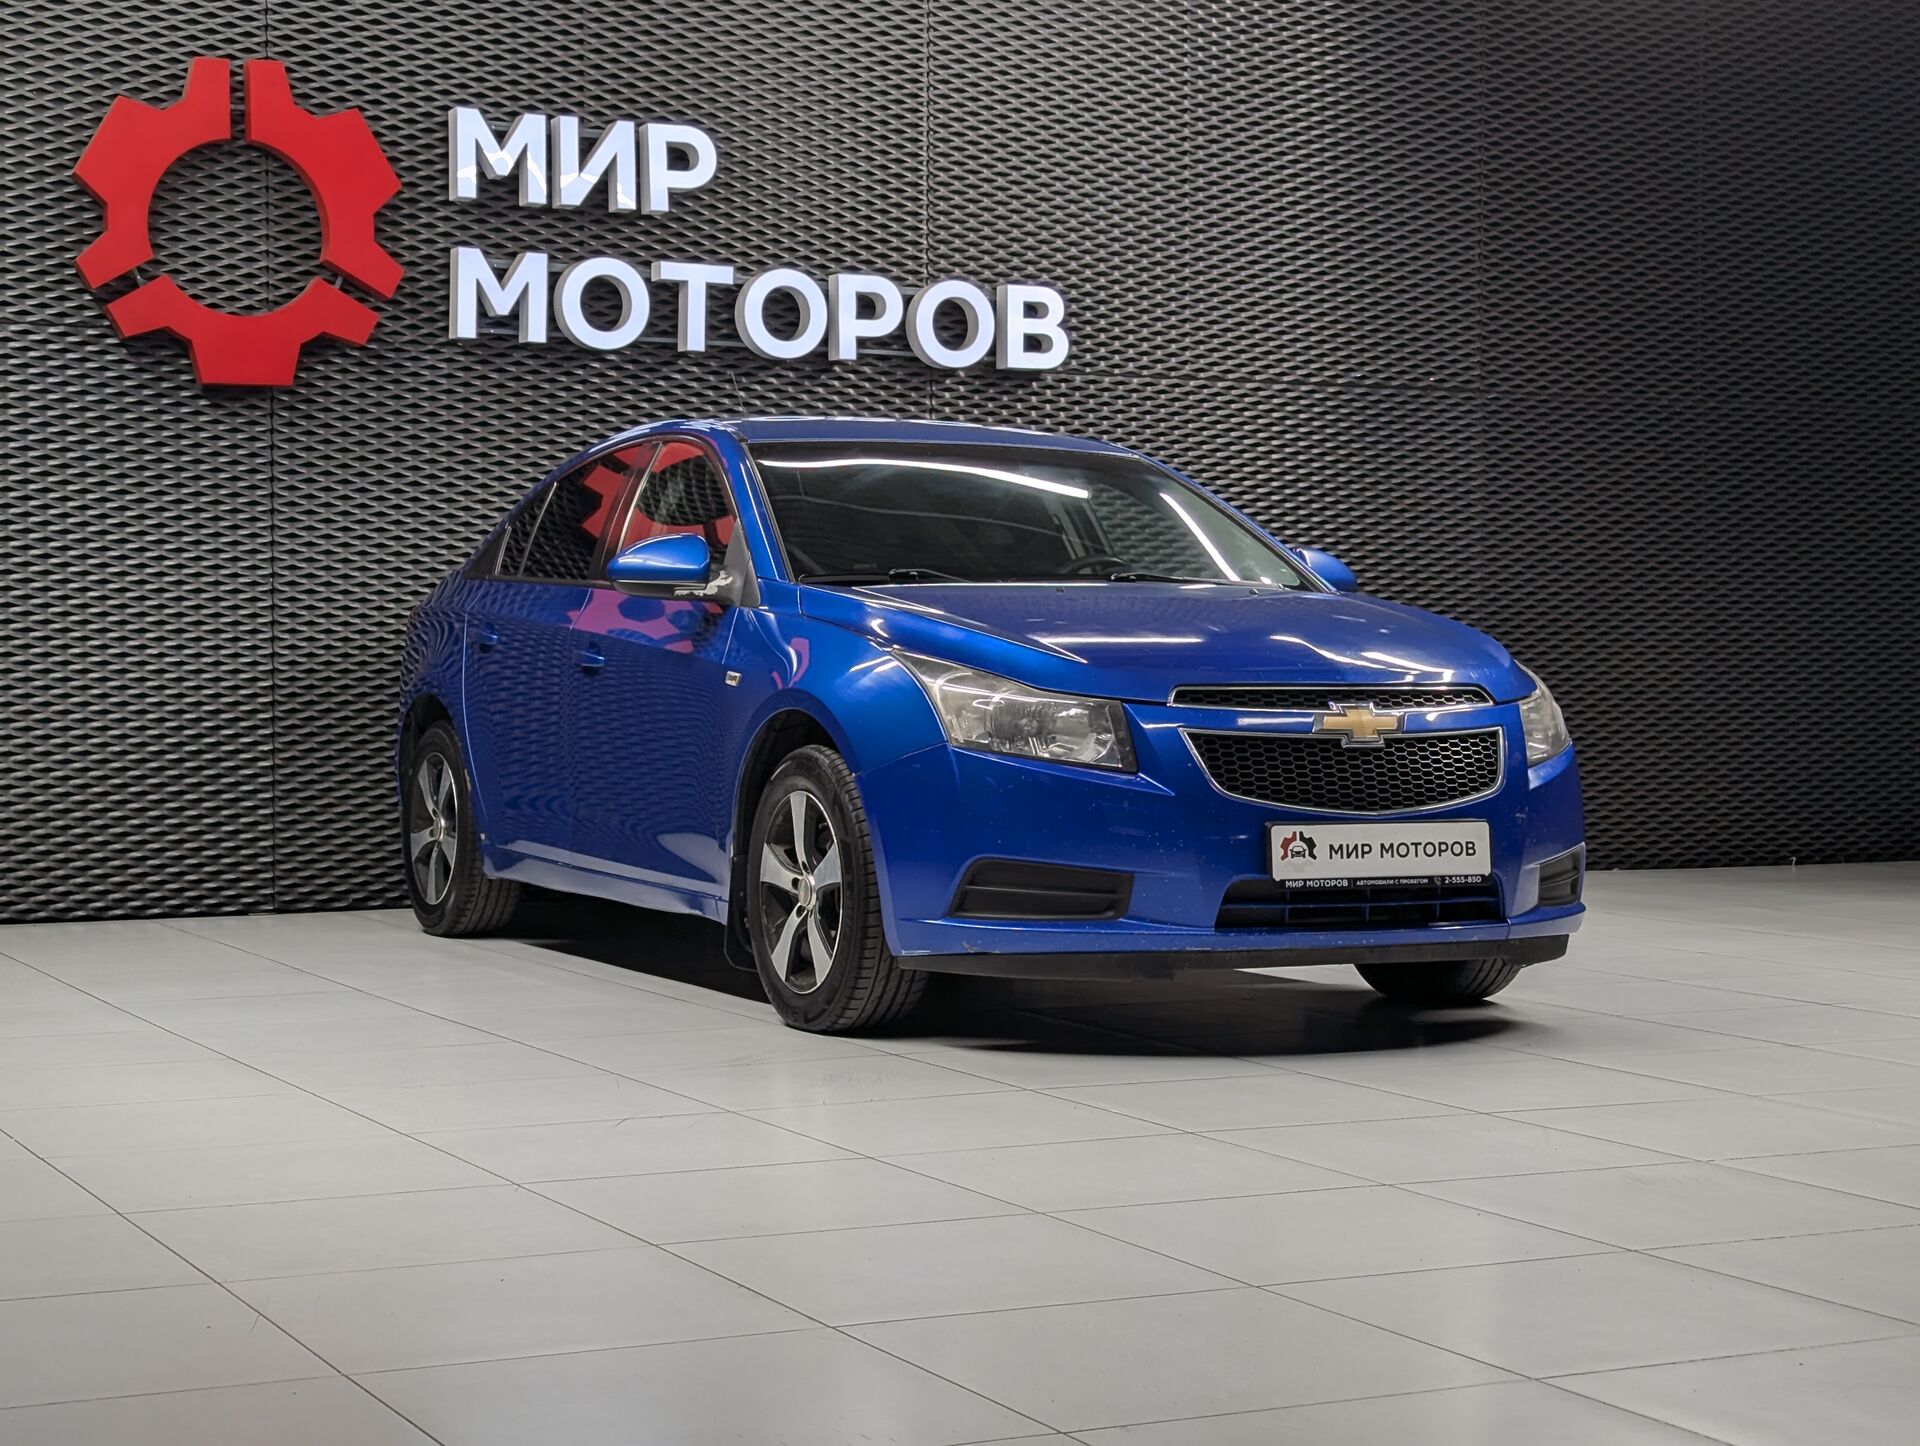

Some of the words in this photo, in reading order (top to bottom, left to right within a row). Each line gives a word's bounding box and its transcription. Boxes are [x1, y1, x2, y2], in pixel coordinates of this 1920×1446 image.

[448, 106, 717, 214] МИР
[449, 246, 1069, 370] МОТОРОВ
[1285, 880, 1304, 888] МИР
[1306, 879, 1349, 888] МОТОРОВ
[1444, 876, 1482, 884] 2-555-850
[1328, 842, 1373, 860] МИР
[1379, 840, 1477, 859] МОТОРОВ
